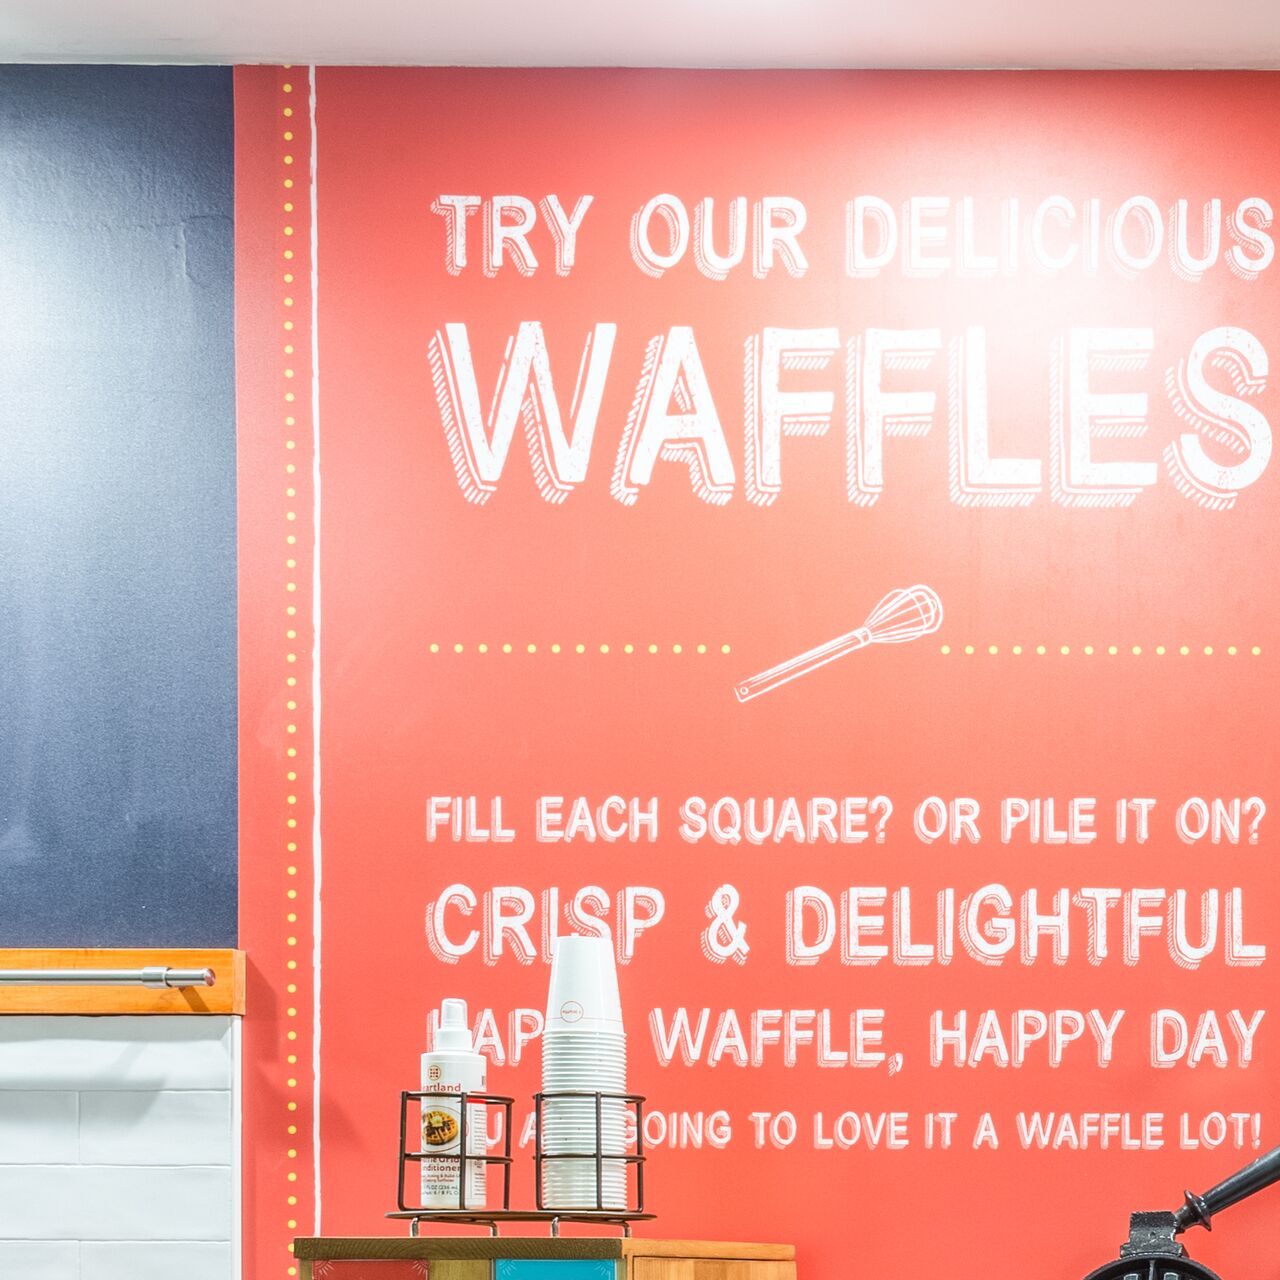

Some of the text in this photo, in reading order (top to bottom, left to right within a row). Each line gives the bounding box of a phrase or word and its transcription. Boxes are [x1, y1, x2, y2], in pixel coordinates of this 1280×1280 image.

[431, 192, 1276, 281] TRY OUR DELICIOUS
[427, 320, 1273, 512] WAFFLES
[426, 796, 1266, 845] FILL EACH SQUARE? OR PILE IT ON?
[425, 883, 1266, 969] CRISP & DELIGHTFUL
[648, 1008, 903, 1077] WAFFLE,
[930, 1009, 1126, 1068] HAPPY
[1151, 1009, 1266, 1068] DAY
[751, 1110, 797, 1148] TO
[814, 1110, 908, 1150] LOVE
[924, 1112, 958, 1150] IT
[973, 1112, 999, 1149] A
[1016, 1112, 1164, 1150] WAFFLE
[1180, 1112, 1262, 1150] LOT!
